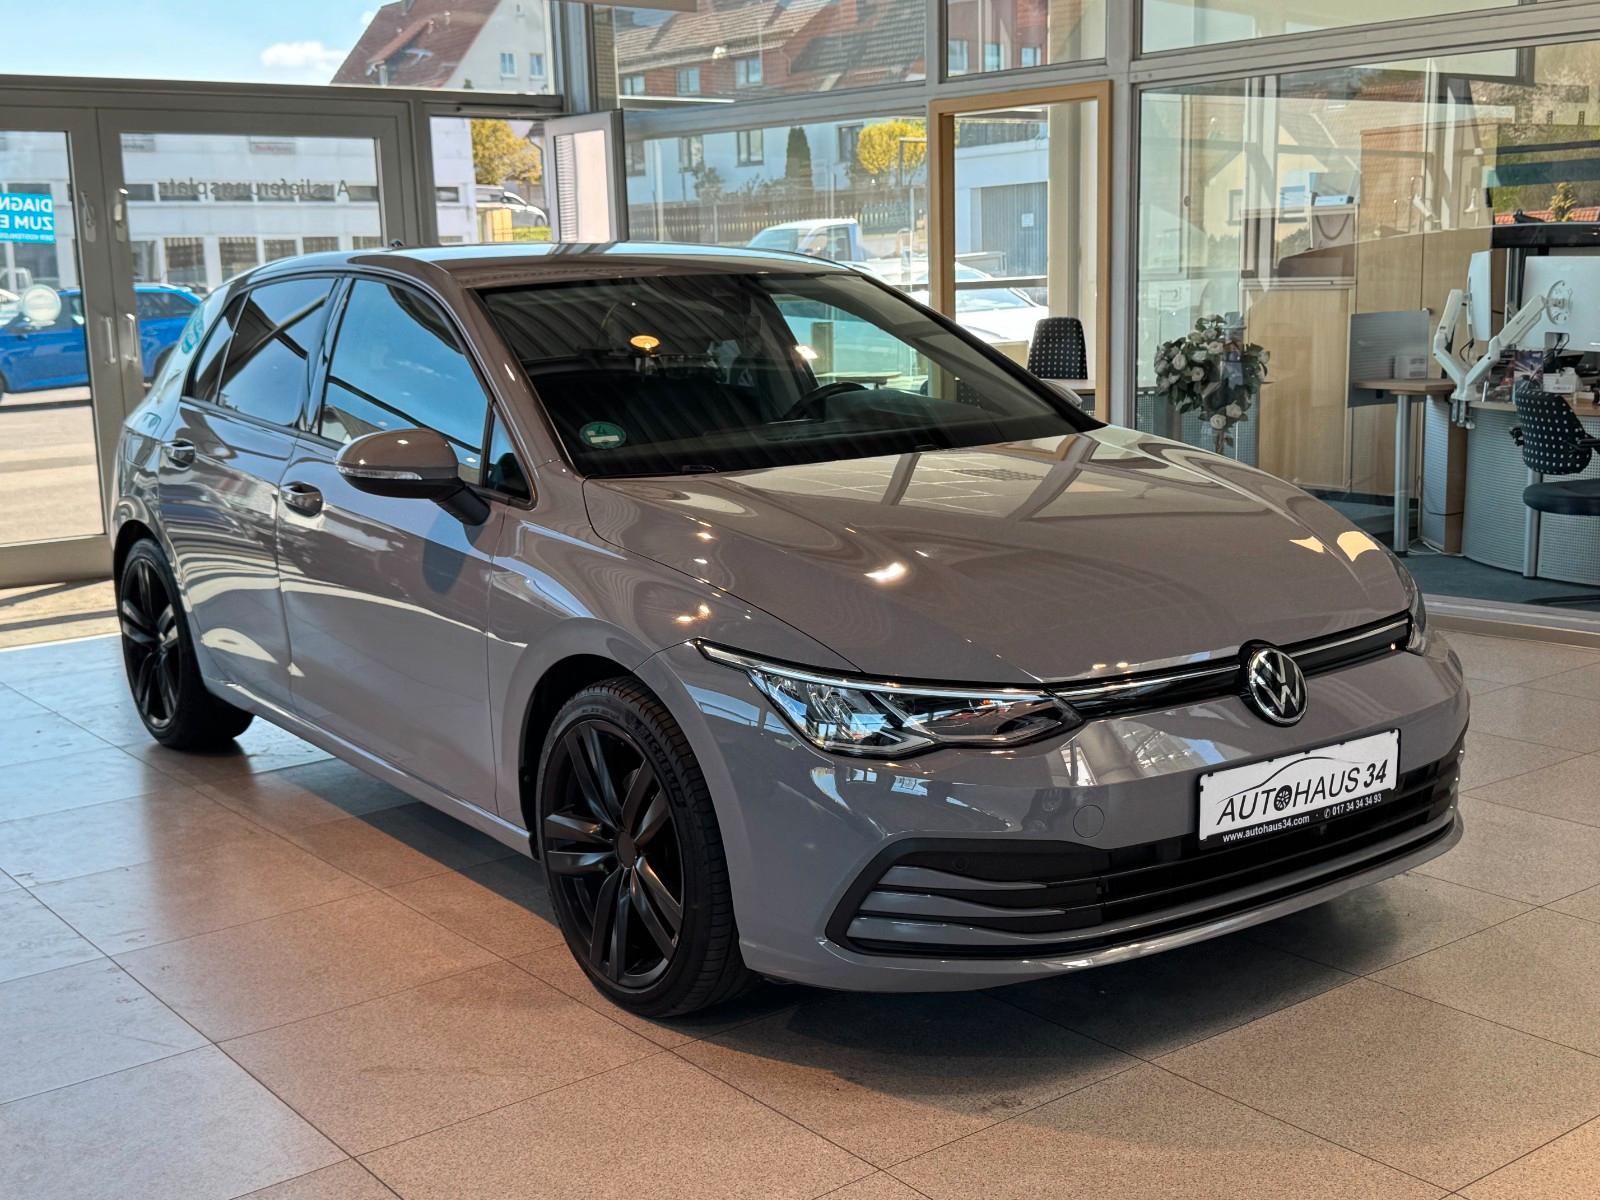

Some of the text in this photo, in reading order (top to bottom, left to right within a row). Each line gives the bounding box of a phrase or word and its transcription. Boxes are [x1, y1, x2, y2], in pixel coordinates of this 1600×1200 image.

[1248, 648, 1308, 723] VW
[1216, 759, 1388, 826] AUTOHAUS 34
[1222, 793, 1382, 843] www.autohaus34.com 017 34 34 34 93
